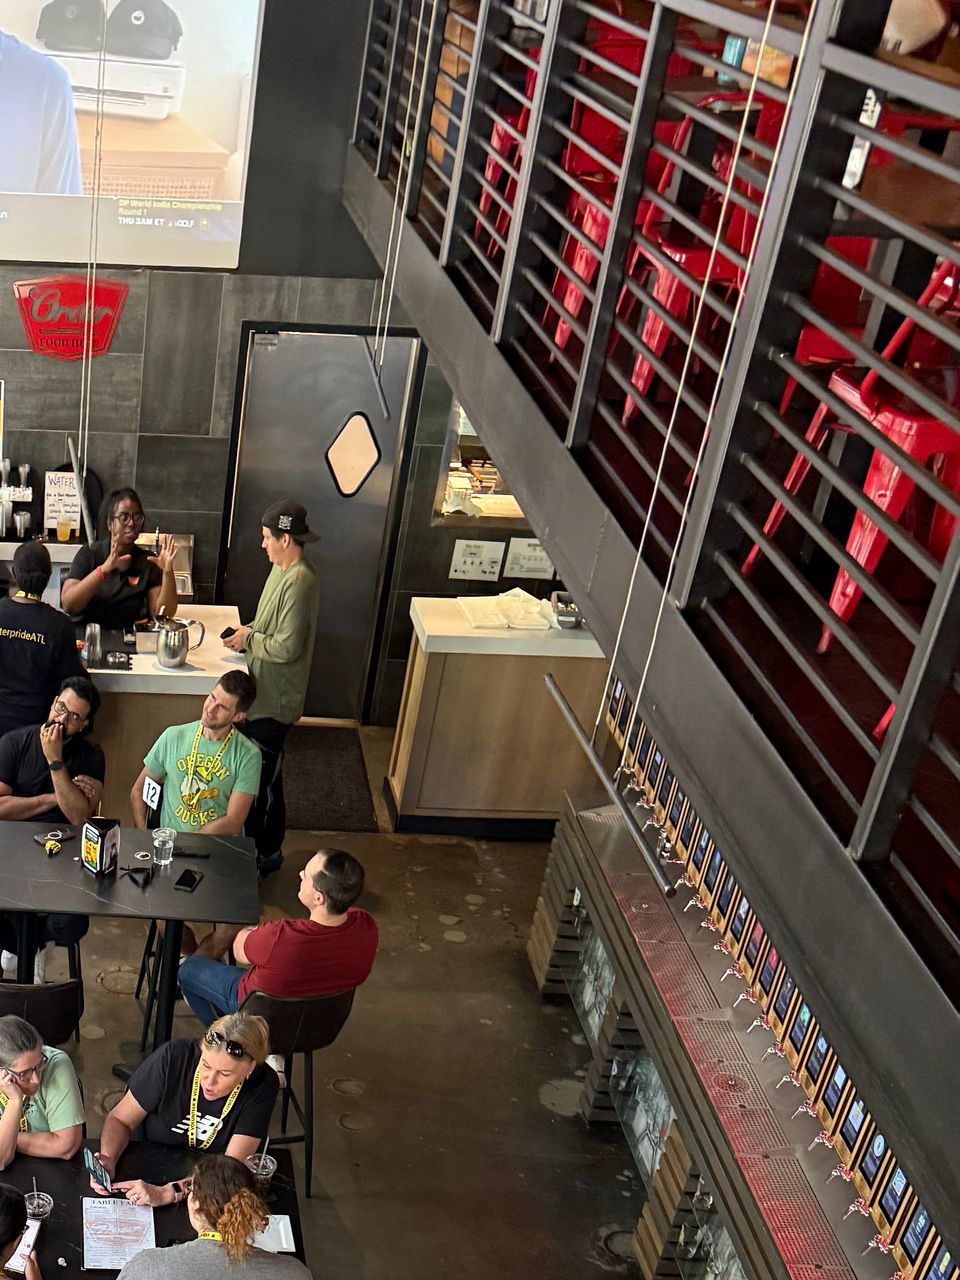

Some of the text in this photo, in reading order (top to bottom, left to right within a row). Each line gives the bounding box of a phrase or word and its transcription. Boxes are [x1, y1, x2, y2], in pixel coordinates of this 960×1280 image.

[119, 217, 134, 225] THU
[48, 473, 77, 490] WATER
[177, 753, 231, 781] OEGN
[146, 782, 158, 803] 12
[175, 804, 218, 826] DUCKS
